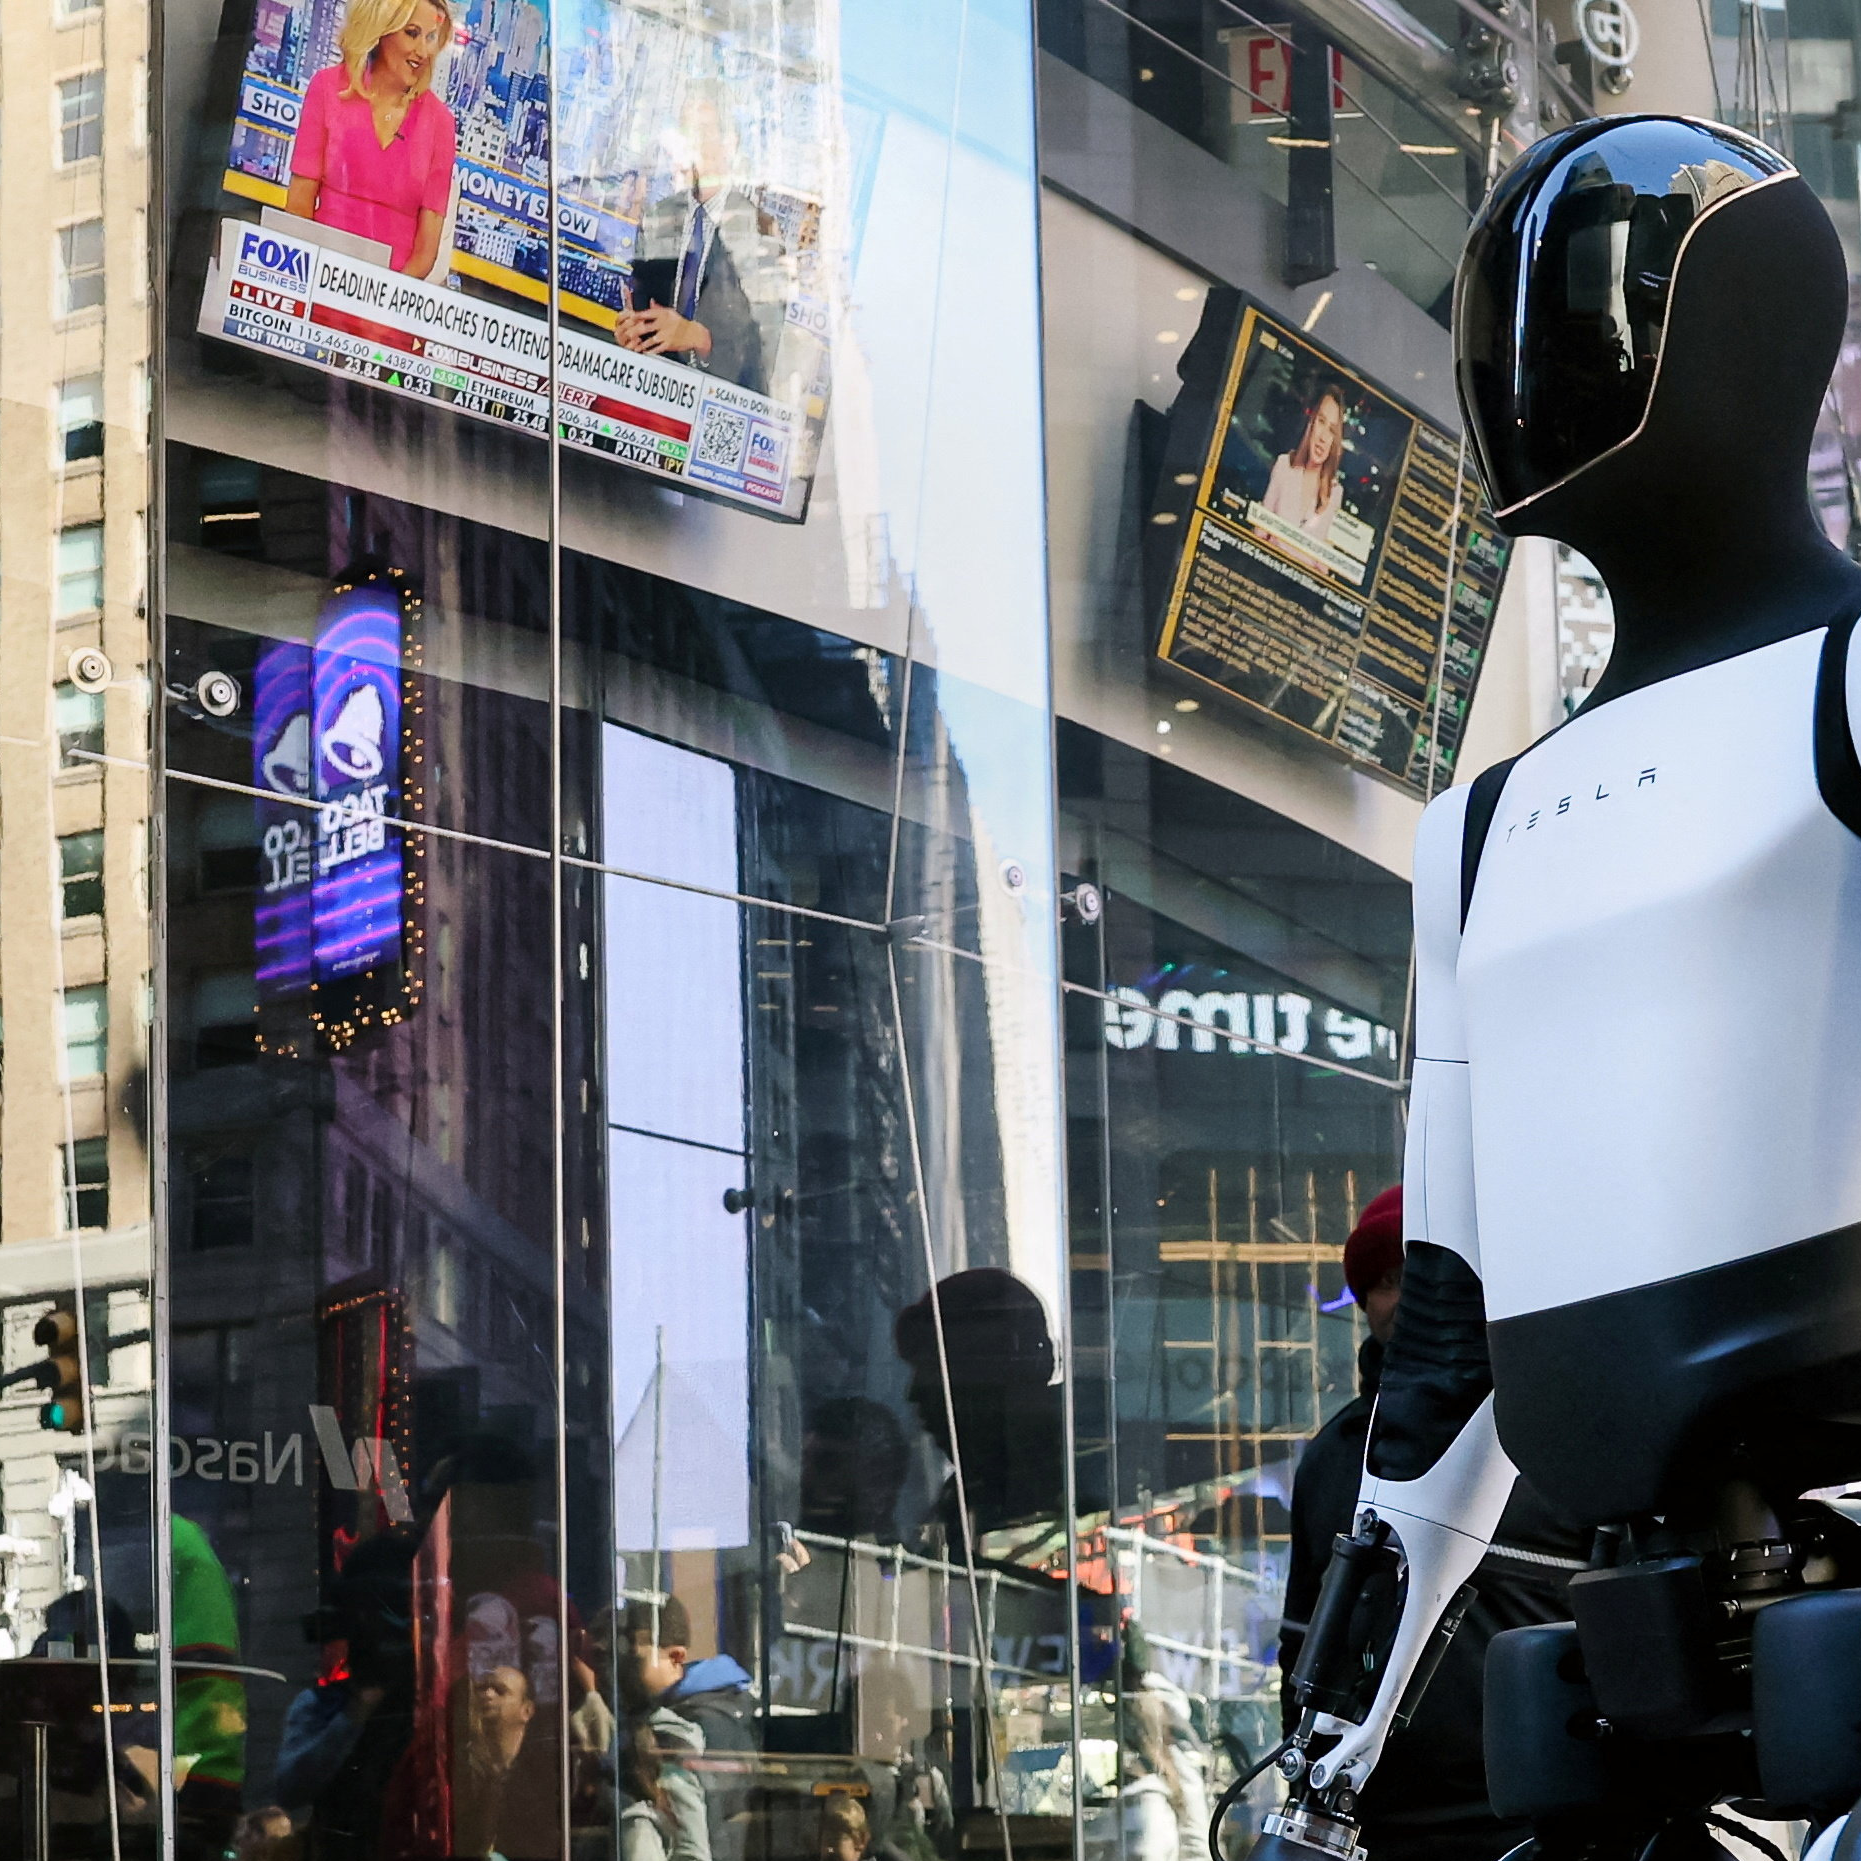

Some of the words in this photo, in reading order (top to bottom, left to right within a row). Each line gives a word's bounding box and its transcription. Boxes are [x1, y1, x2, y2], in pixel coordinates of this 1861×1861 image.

[250, 92, 301, 125] SHO
[454, 162, 527, 217] MONEY
[533, 197, 593, 239] SOW
[238, 264, 307, 294] BUSINESS
[241, 232, 307, 281] FOX
[241, 285, 297, 316] LIVE
[319, 263, 387, 309] DEADLINE
[388, 286, 480, 336] APPROACHES
[481, 316, 499, 344] TO
[500, 324, 551, 361] EXTEND
[557, 341, 634, 389] OBAMACARE
[638, 368, 696, 409] SUBSIDIES
[229, 304, 291, 334] BITCOIN
[385, 352, 431, 377] 4387.00
[471, 380, 534, 410] ETHEREUM
[614, 426, 655, 447] 266.24
[236, 323, 264, 342] LAST
[266, 330, 306, 355] TRADES
[344, 356, 381, 380] 23.84
[403, 375, 432, 396] 0.33
[452, 391, 488, 413] AT&T
[512, 410, 547, 432] 25.48
[567, 427, 594, 447] 0.34
[614, 441, 661, 468] PAYPAL
[458, 350, 539, 391] BUSINESS
[1506, 767, 1657, 843] TESLA
